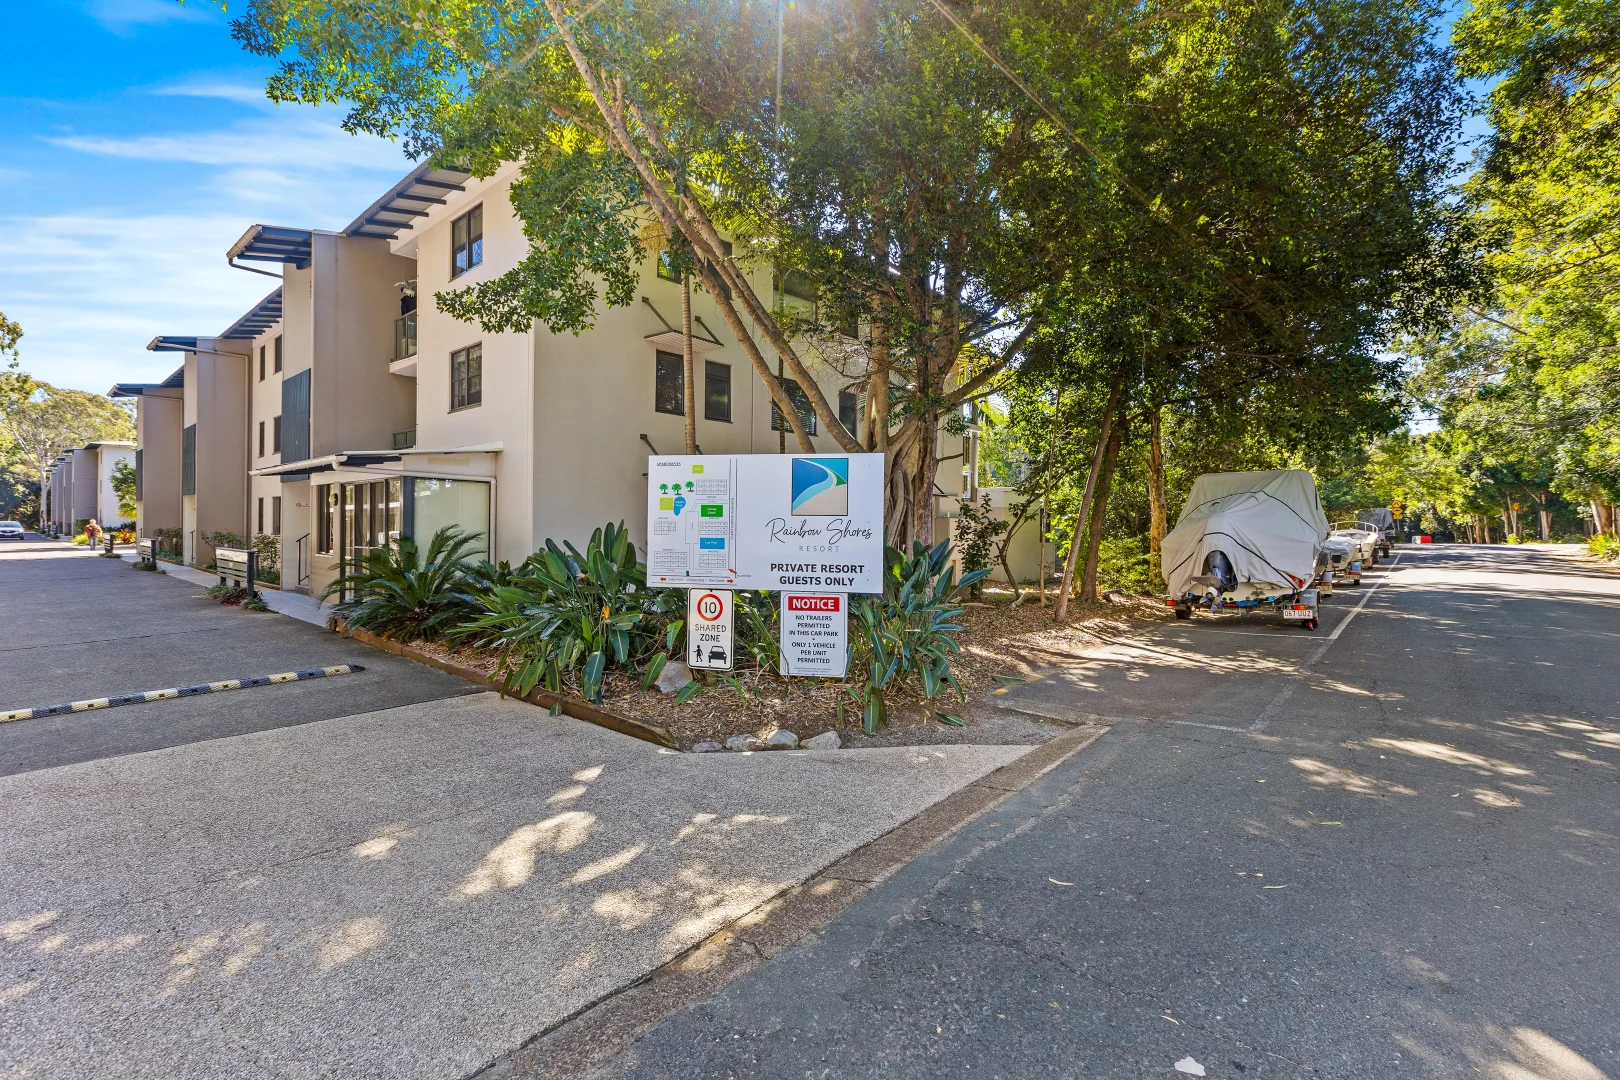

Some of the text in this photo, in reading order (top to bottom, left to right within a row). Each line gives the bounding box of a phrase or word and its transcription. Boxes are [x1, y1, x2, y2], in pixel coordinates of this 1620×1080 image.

[765, 517, 822, 544] Rainbow
[826, 518, 873, 545] Shores
[770, 563, 865, 574] PRIVATE RESORT
[779, 575, 855, 586] GUESTS ONLY
[704, 601, 717, 614] 10
[792, 598, 835, 610] NOTICE
[694, 623, 727, 633] SHARED
[699, 633, 721, 643] ZONE
